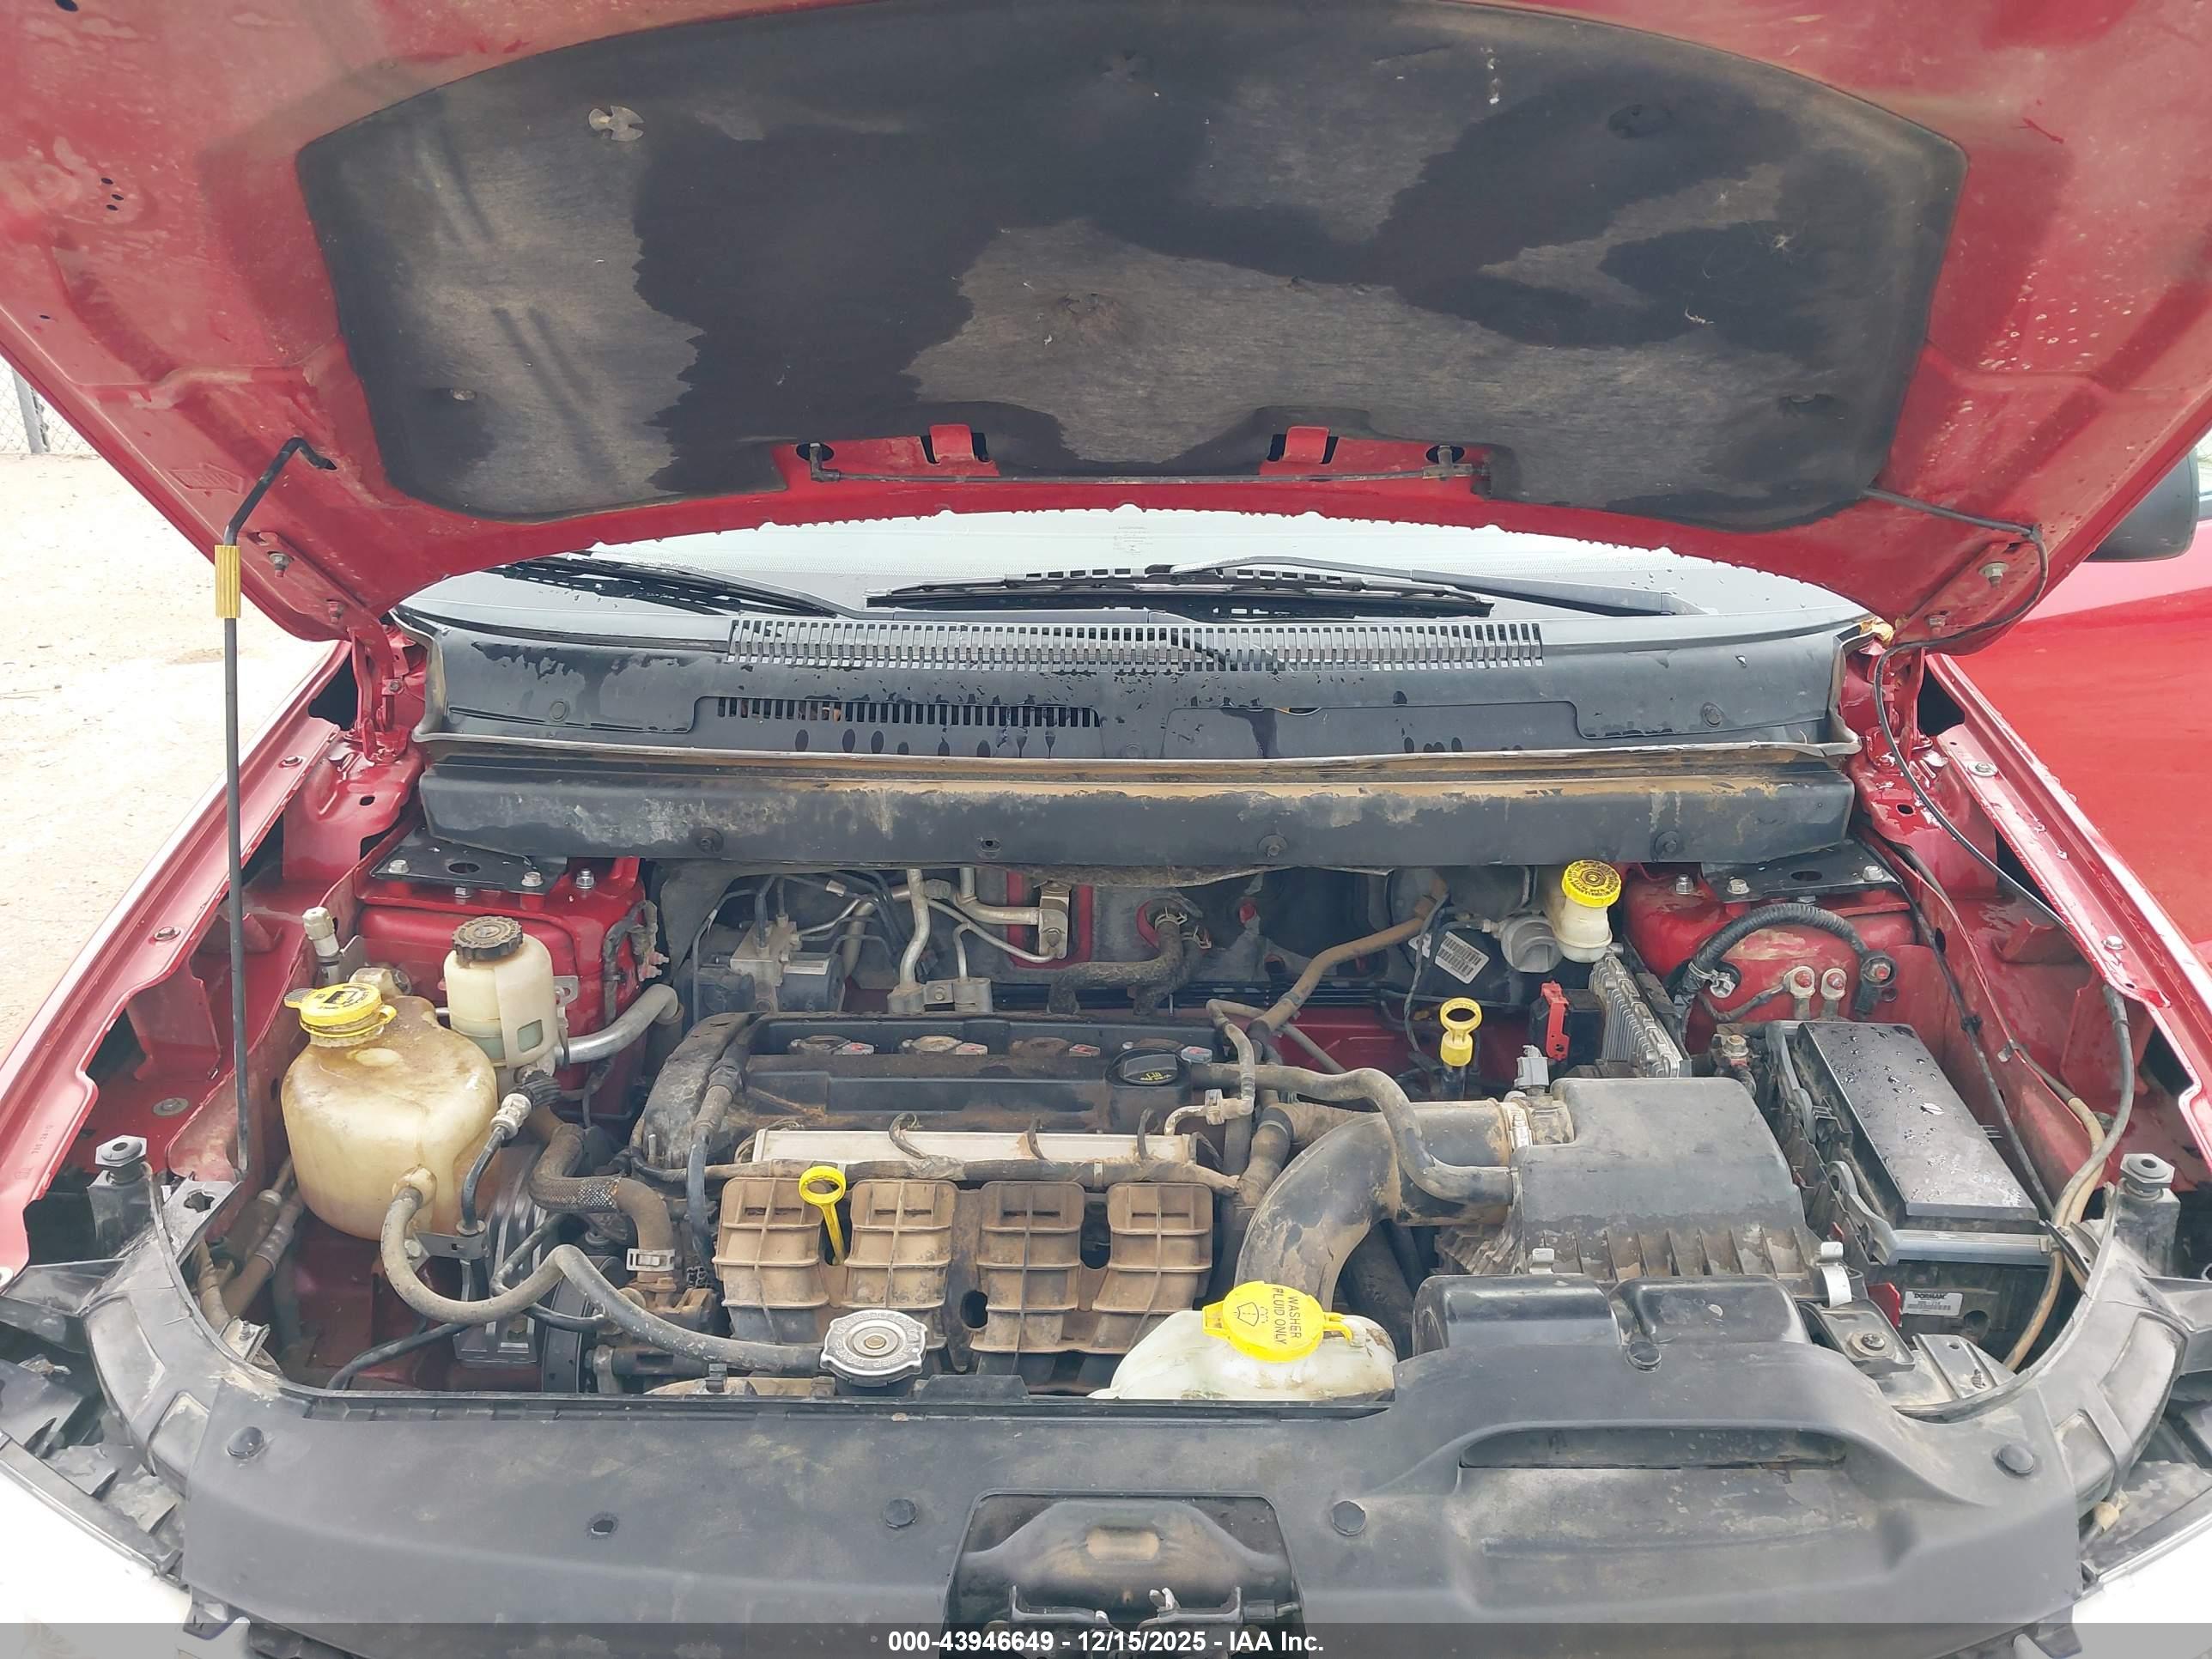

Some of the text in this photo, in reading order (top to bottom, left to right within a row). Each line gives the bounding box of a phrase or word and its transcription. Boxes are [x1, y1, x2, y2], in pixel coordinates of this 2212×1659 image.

[1272, 1287, 1287, 1345] FLUID ONLY
[1287, 1296, 1302, 1339] WASHER
